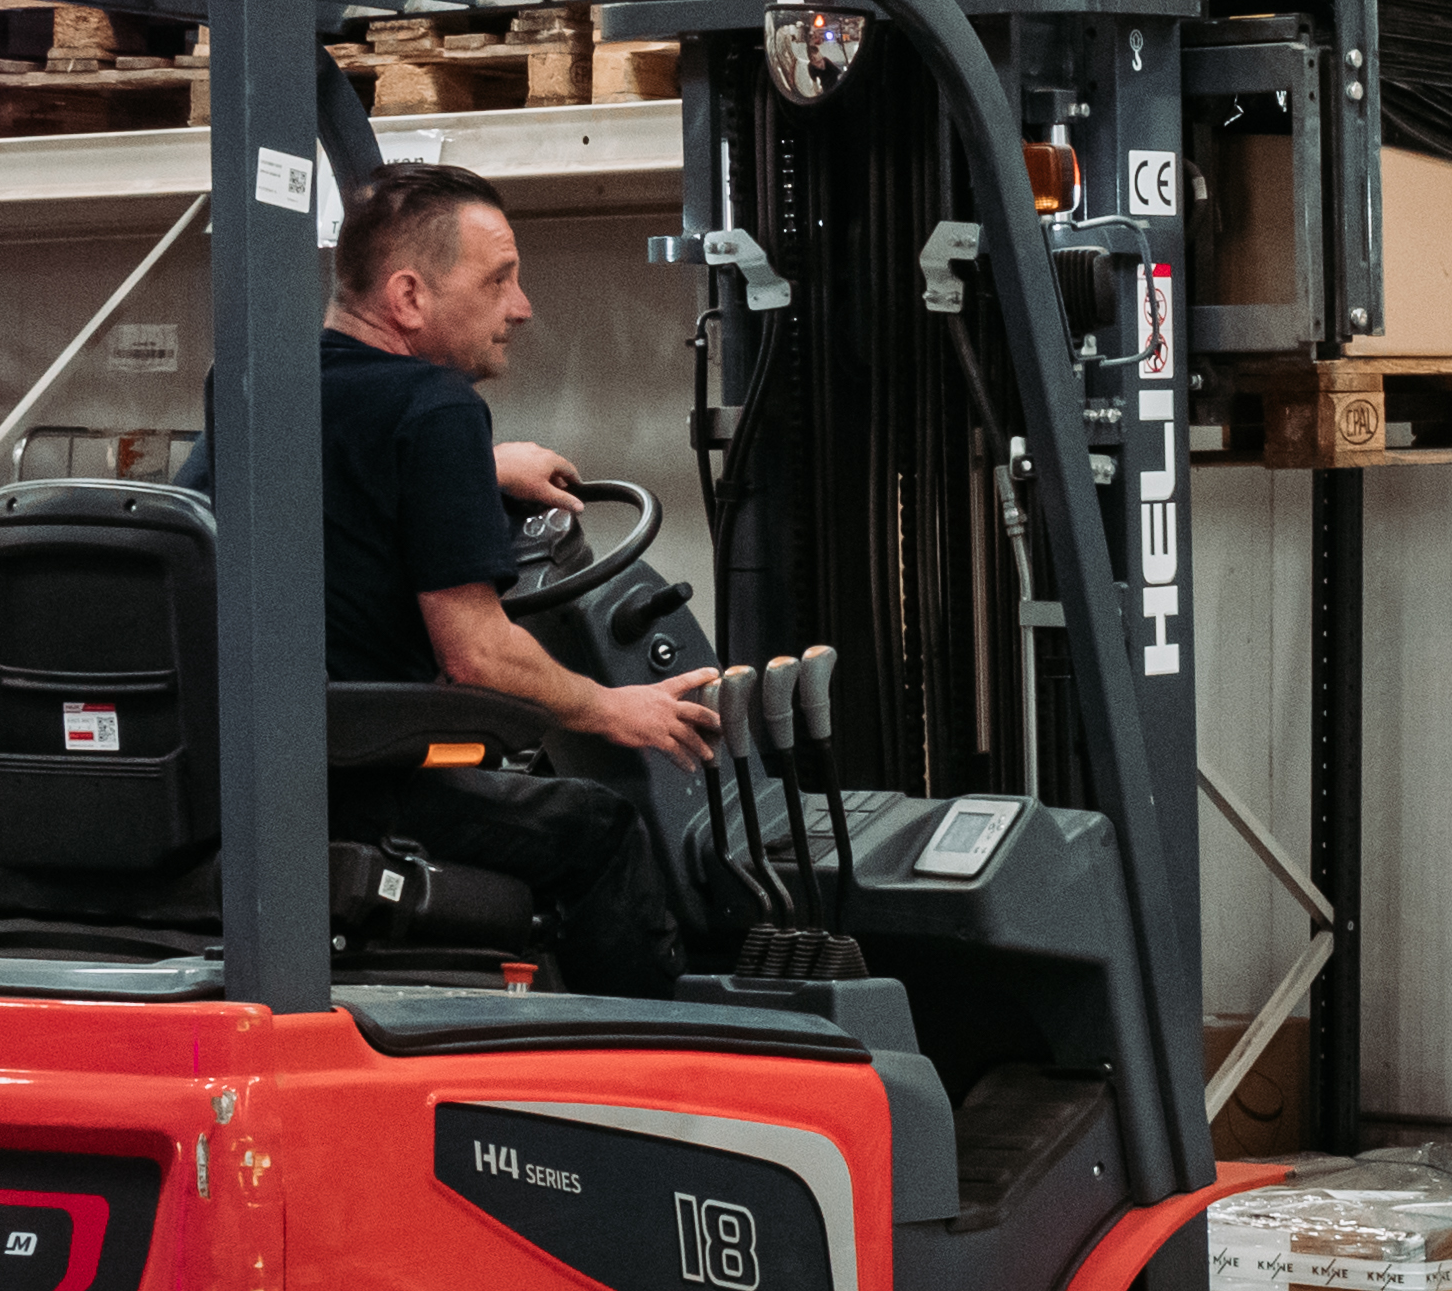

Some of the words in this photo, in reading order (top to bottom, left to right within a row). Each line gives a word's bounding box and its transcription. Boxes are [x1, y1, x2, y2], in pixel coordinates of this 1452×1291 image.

[1134, 160, 1172, 206] CE
[1138, 390, 1180, 676] HELI
[474, 1140, 520, 1179] H4
[525, 1163, 582, 1194] SERIES
